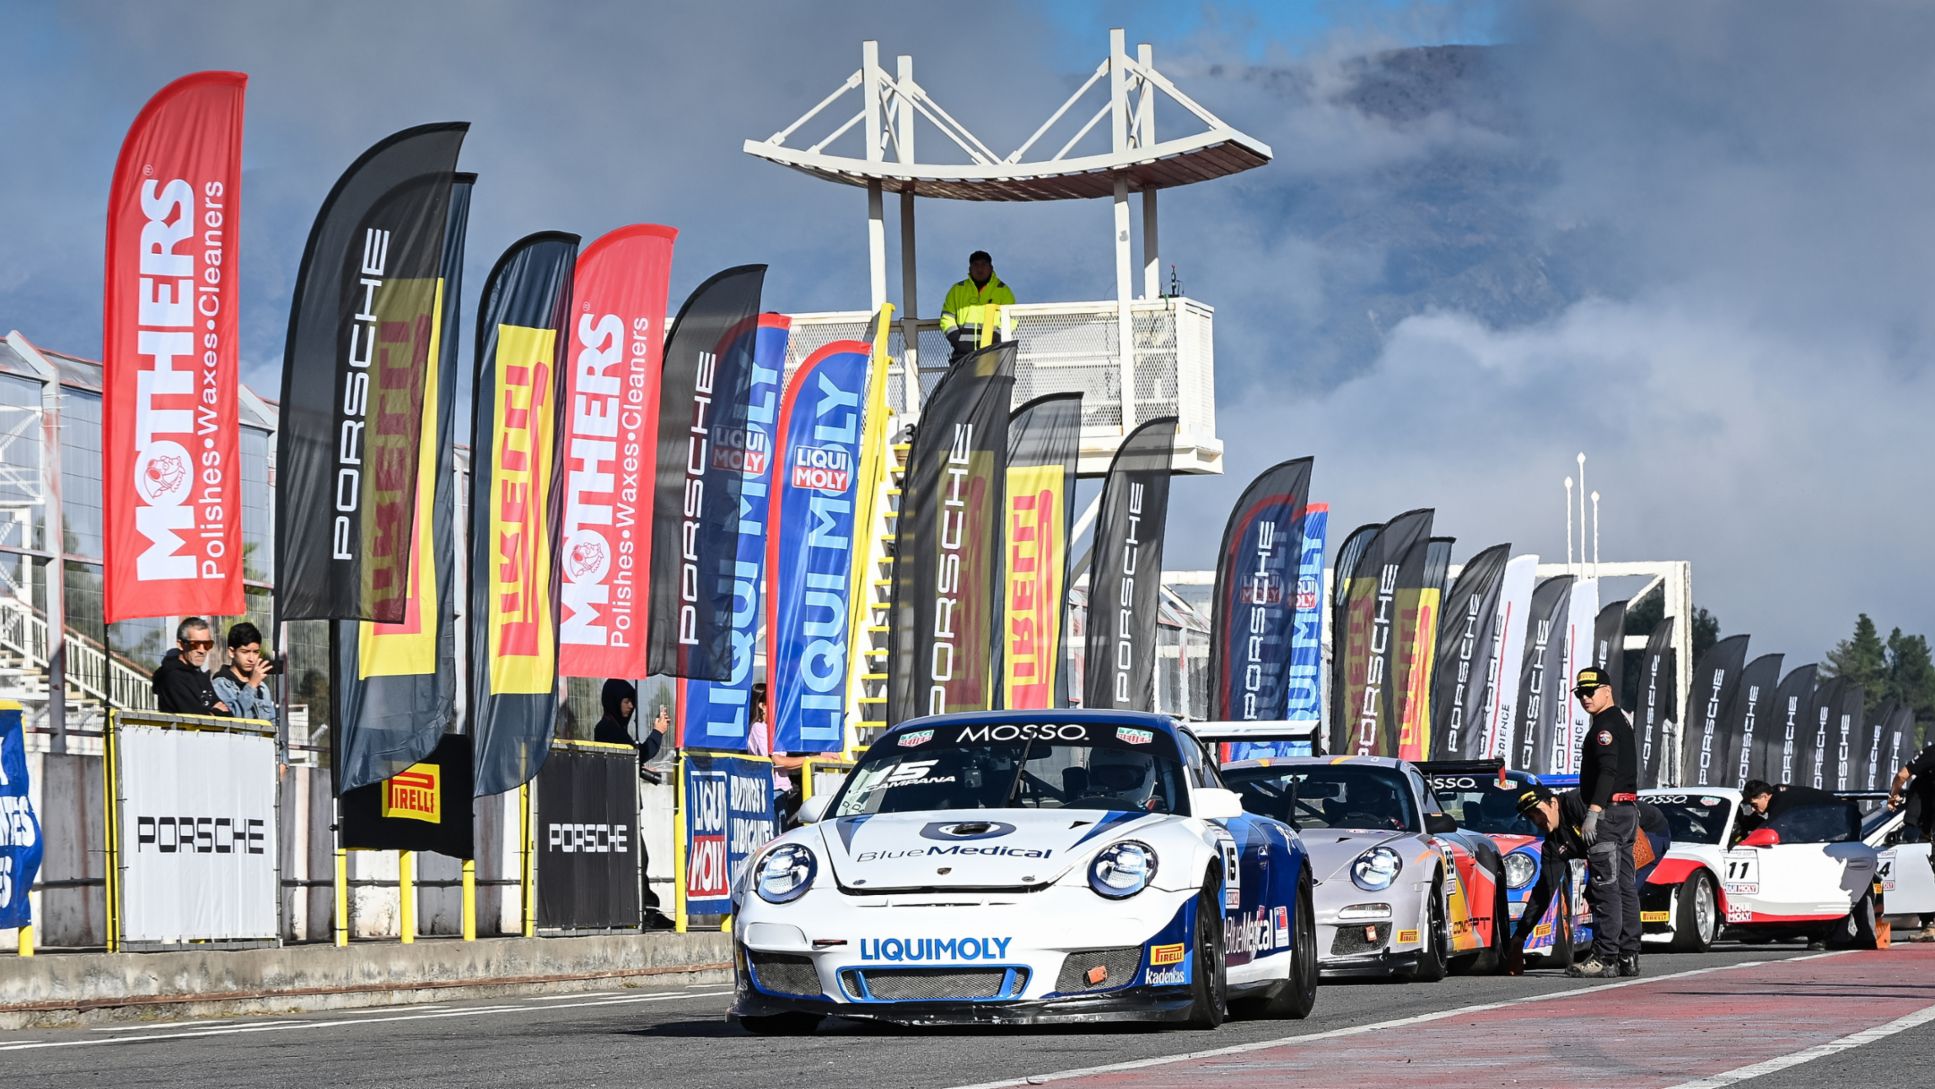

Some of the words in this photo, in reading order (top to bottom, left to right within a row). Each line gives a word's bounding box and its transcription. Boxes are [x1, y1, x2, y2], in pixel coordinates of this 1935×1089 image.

[333, 228, 390, 560] PORSCHE
[680, 351, 716, 646] PORSCHE
[792, 466, 848, 492] MOLY
[796, 446, 847, 471] LIQUI
[929, 423, 973, 716] PORSCHE
[1115, 482, 1144, 703] PORSCHE
[800, 572, 848, 742] LIQUI
[1243, 520, 1275, 720] PORSCHE
[1447, 593, 1480, 752] PORSCHE
[1522, 619, 1550, 769] ORSCHE
[1556, 638, 1569, 775] ORSCHE
[1643, 654, 1660, 770] ORSCHE
[1699, 668, 1725, 785] PORSCHE
[1782, 696, 1798, 785] ORSCHE
[1814, 706, 1829, 790] ORSCHE
[1838, 714, 1850, 790] RSCHE
[138, 816, 264, 854] PORSCHE
[388, 772, 435, 813] PIRELLI
[692, 781, 726, 834] LIQUI
[549, 823, 628, 852] PORSCHE
[857, 845, 1052, 863] BlueMedical
[1227, 847, 1236, 881] 15
[1728, 862, 1750, 880] 11
[1156, 946, 1183, 963] PIRELLI
